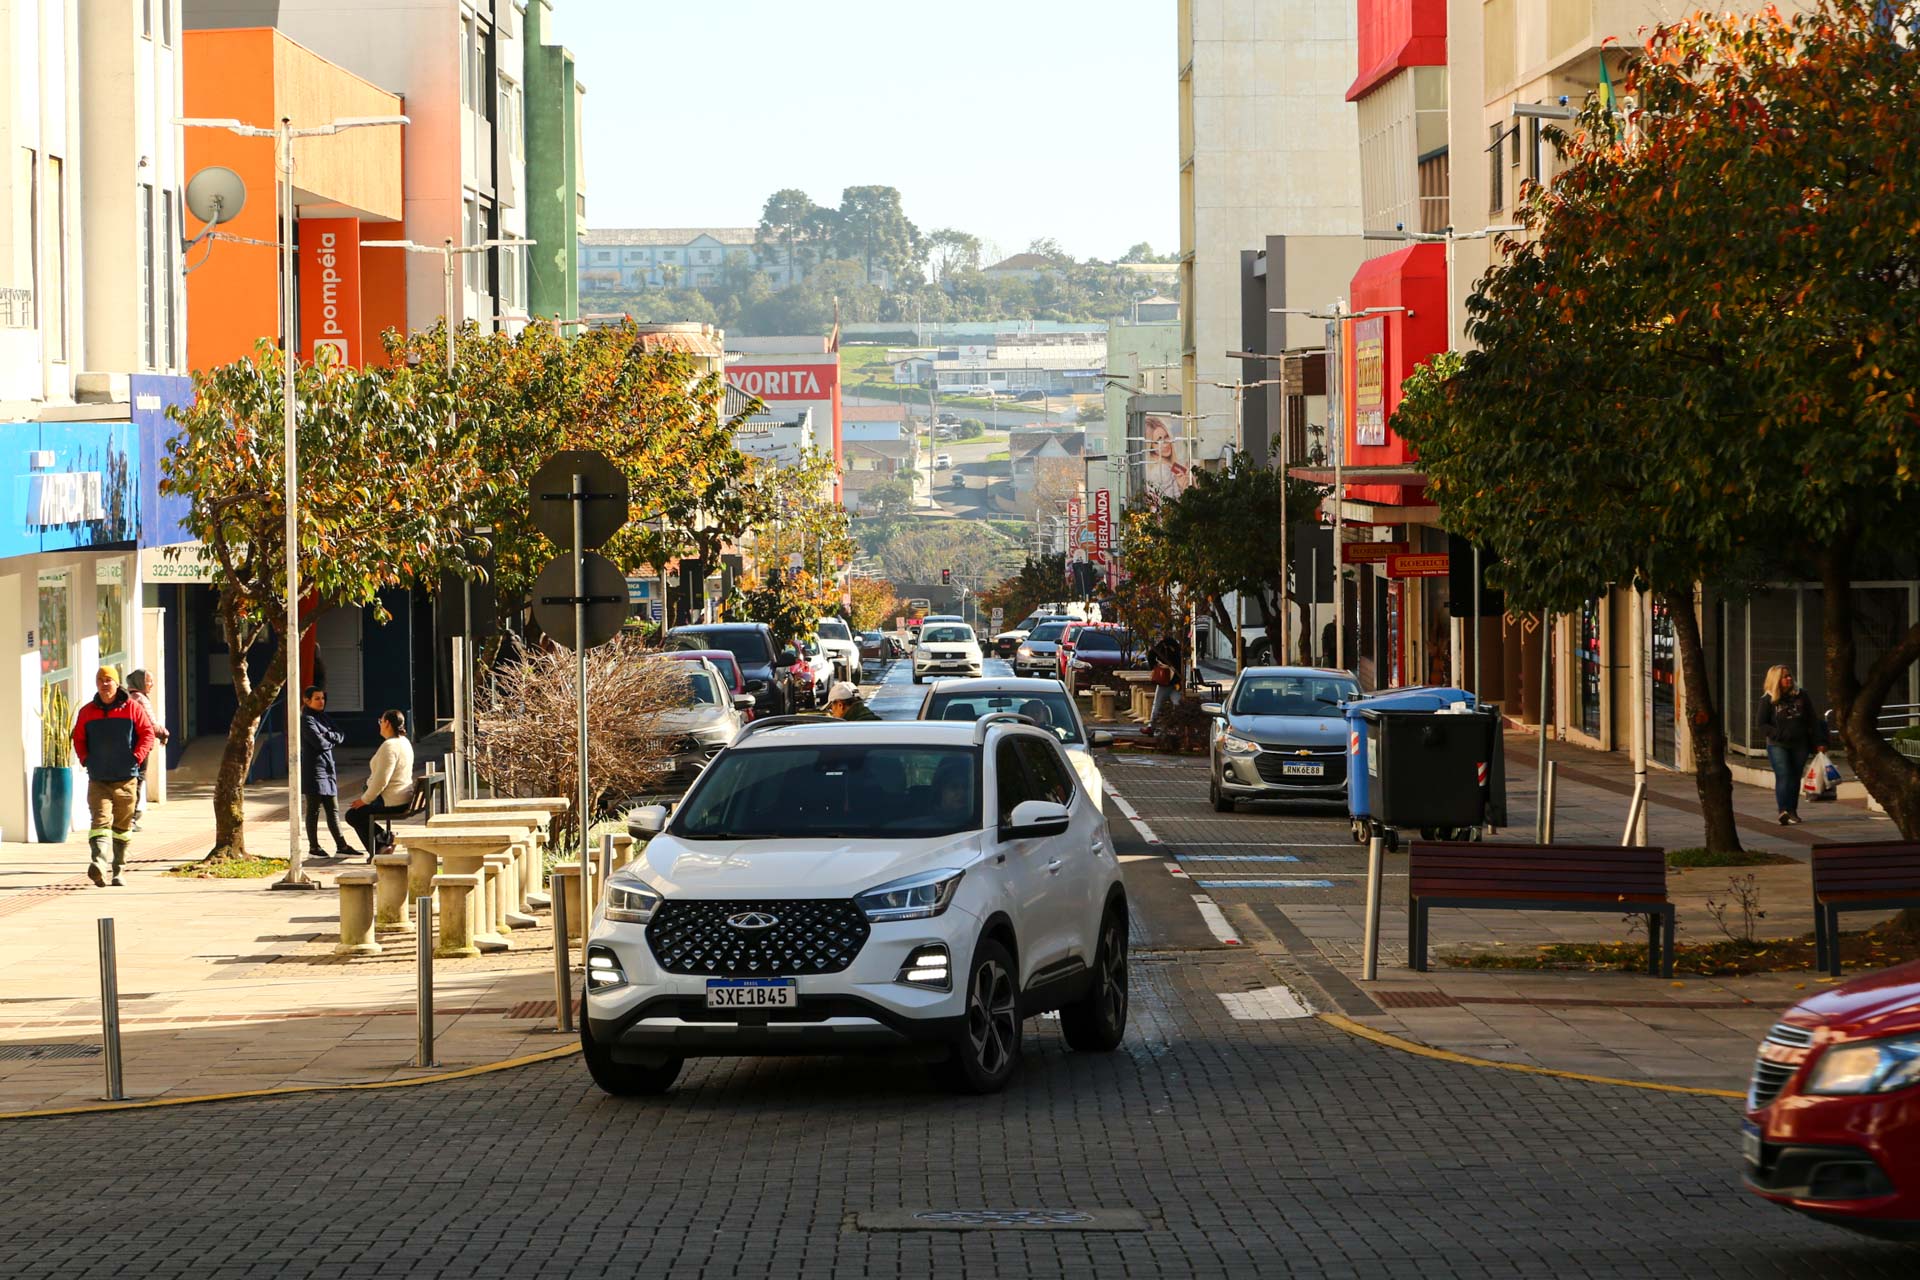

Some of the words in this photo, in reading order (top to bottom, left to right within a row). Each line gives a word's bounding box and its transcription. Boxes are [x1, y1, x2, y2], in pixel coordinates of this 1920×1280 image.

[317, 233, 343, 334] pompéia
[728, 371, 821, 394] VORITA
[1097, 491, 1109, 549] BERLANDA
[152, 564, 201, 577] 3229-2239
[1287, 766, 1321, 774] RNK6E88
[715, 988, 787, 1005] SXE1B45
